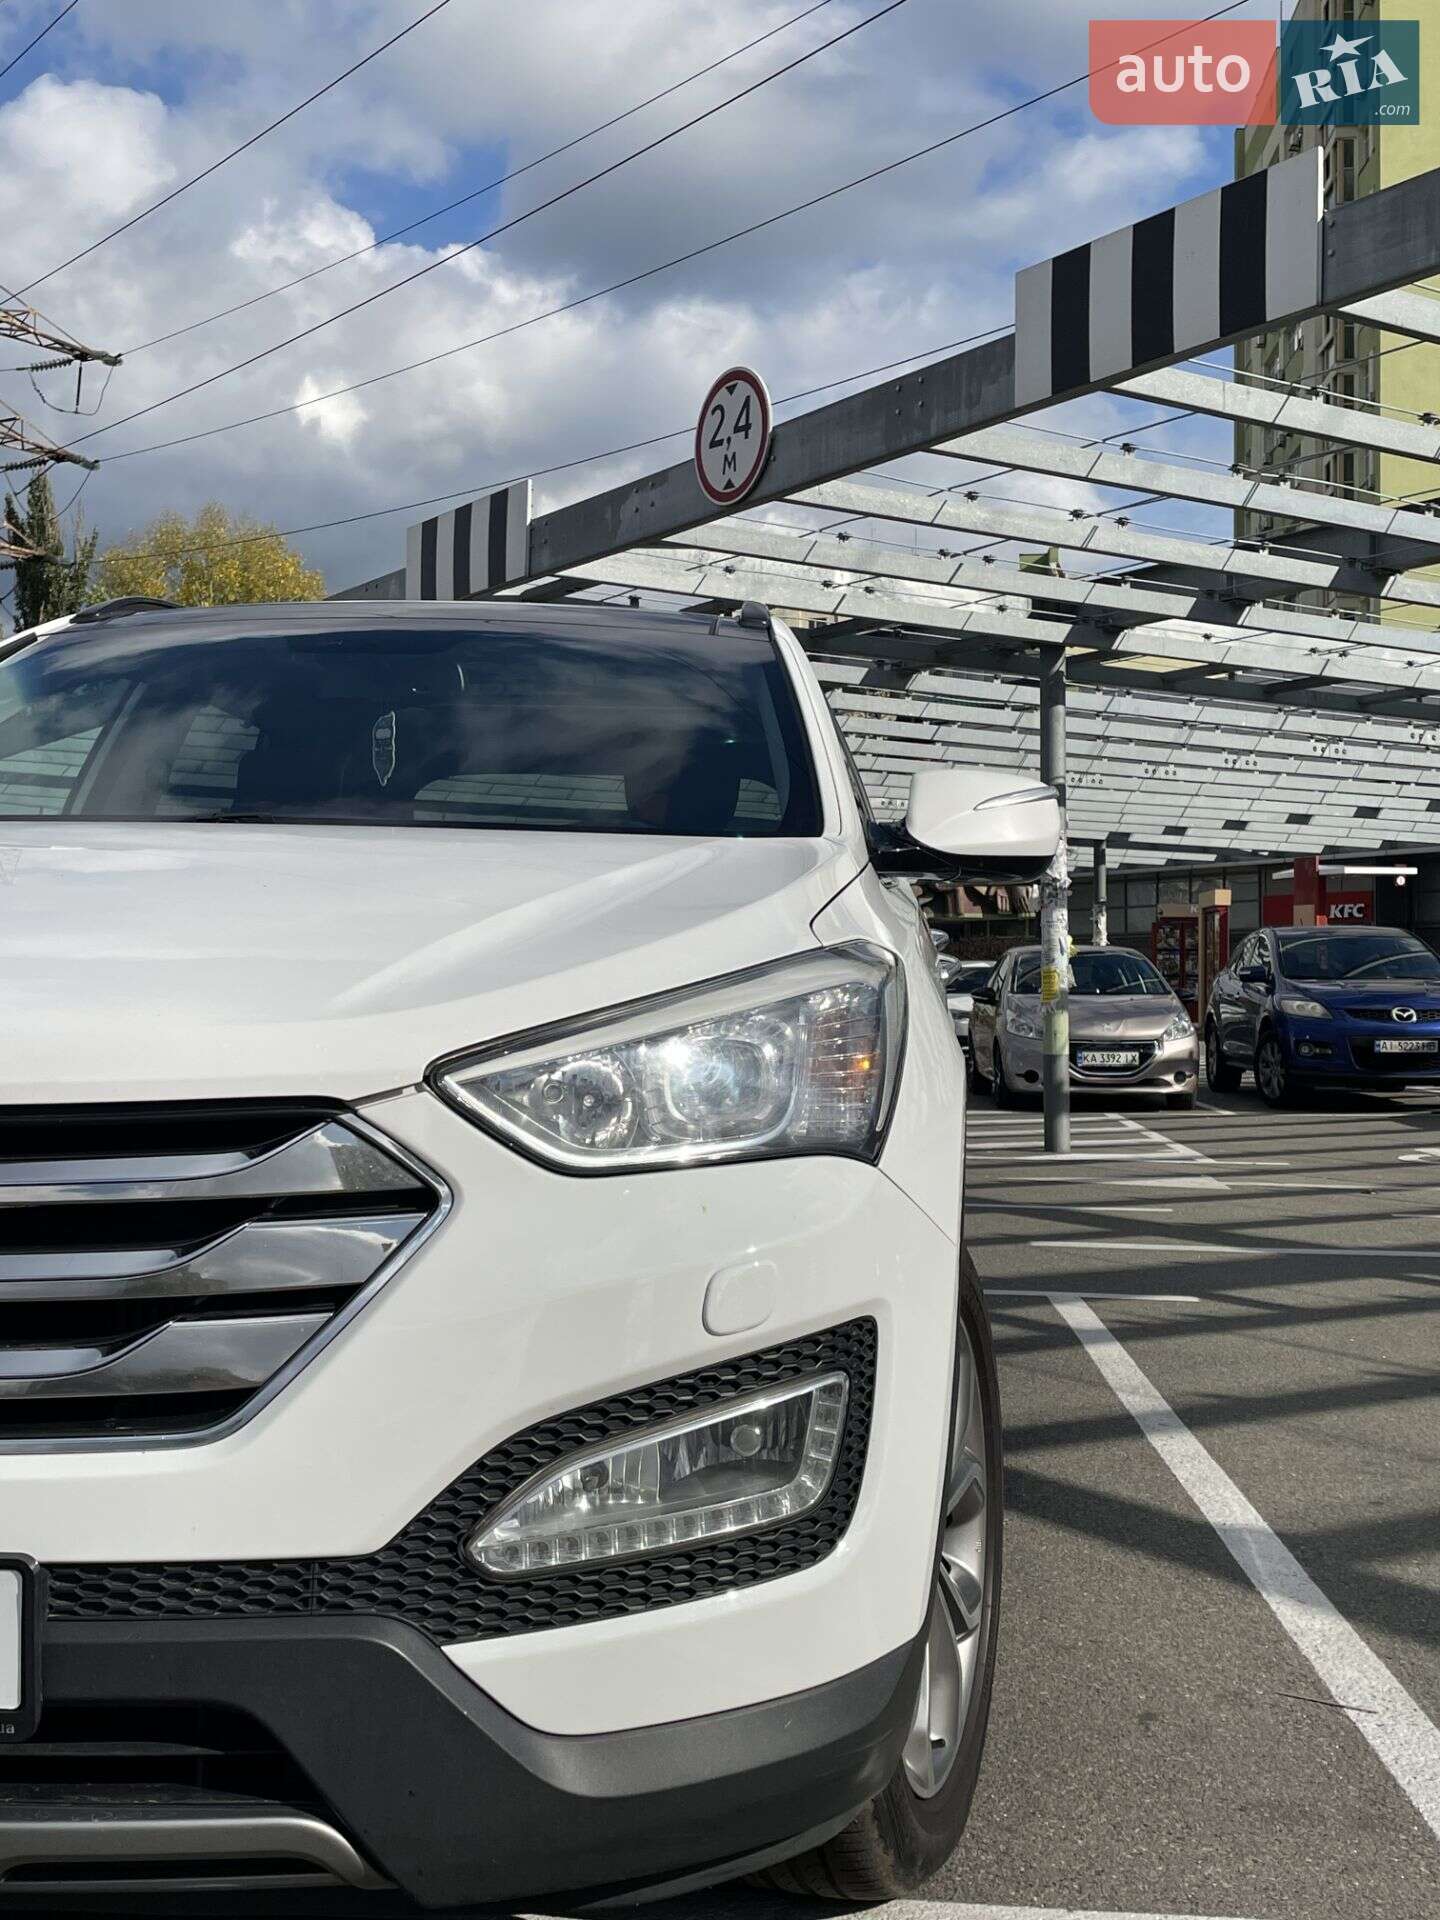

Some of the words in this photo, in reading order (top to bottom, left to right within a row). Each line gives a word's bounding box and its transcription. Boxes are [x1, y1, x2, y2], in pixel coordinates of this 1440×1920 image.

[709, 395, 752, 450] 2,4
[1328, 903, 1365, 919] KFC
[1083, 1053, 1097, 1063] KA
[1100, 1053, 1122, 1063] 3392
